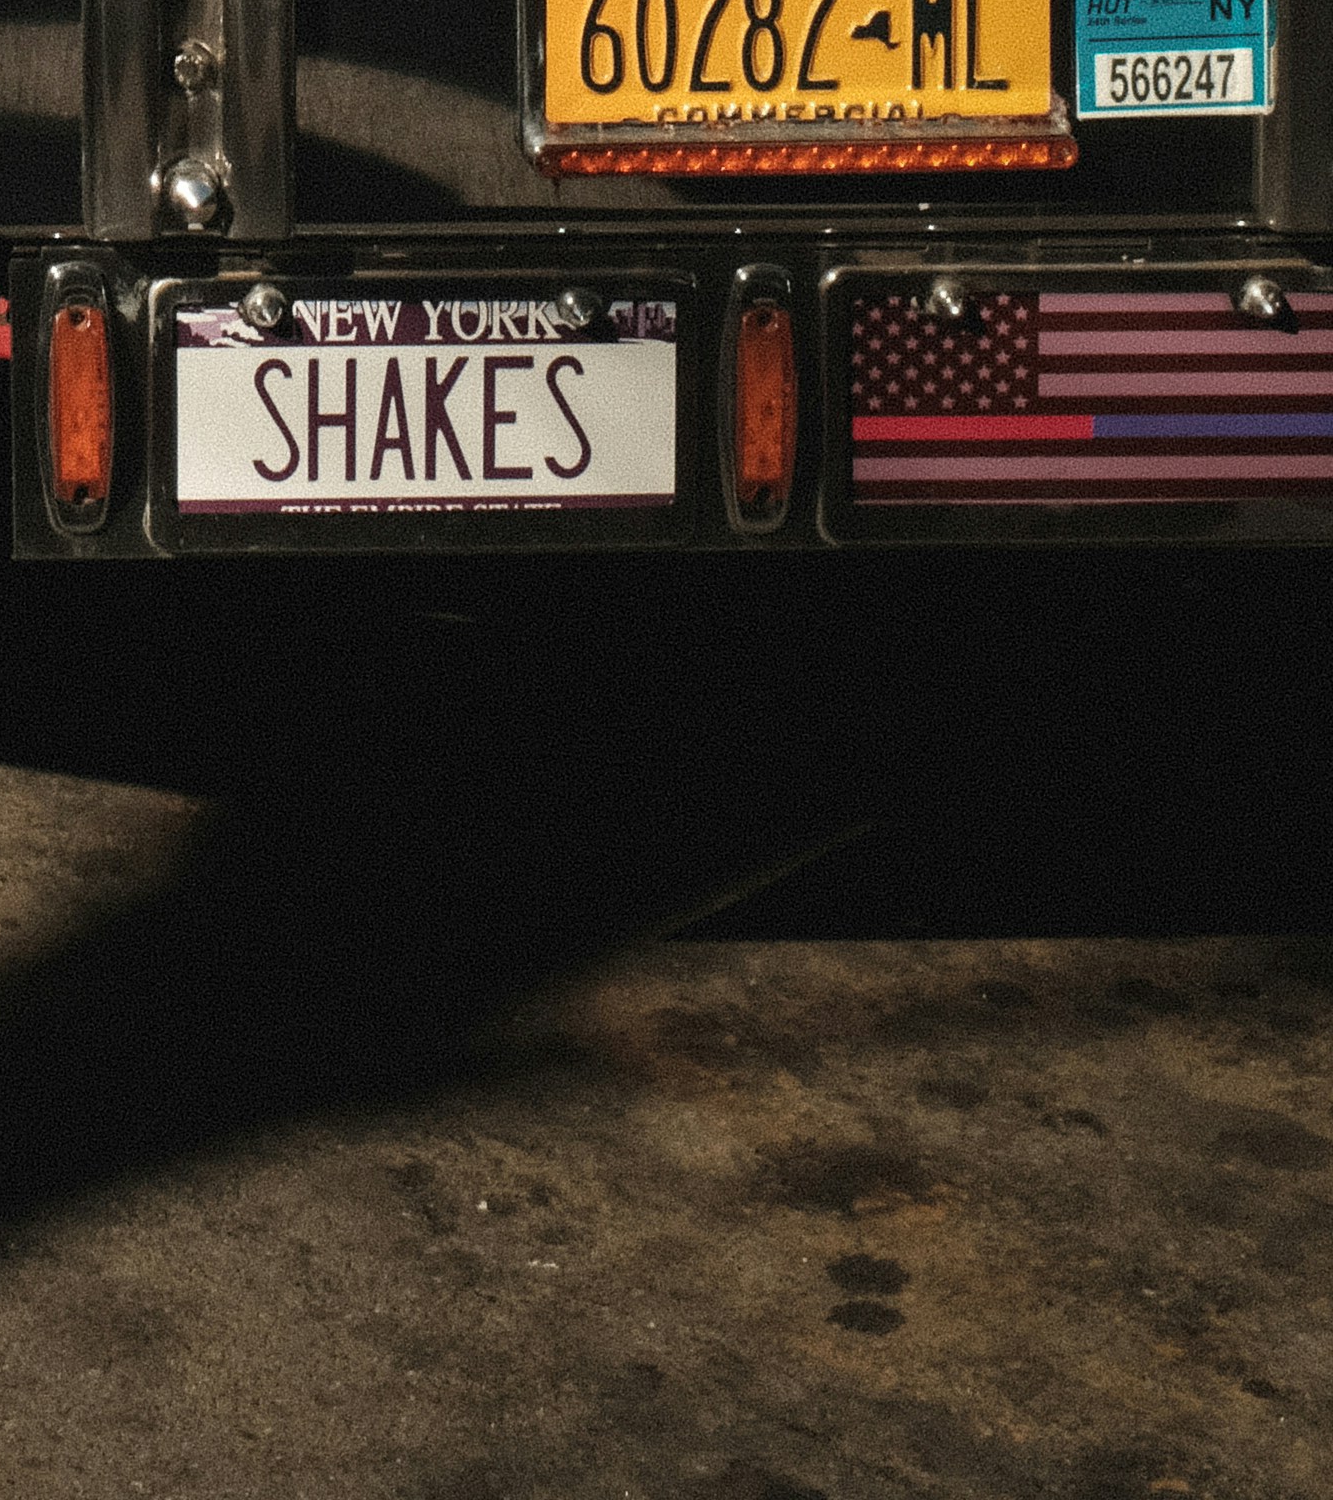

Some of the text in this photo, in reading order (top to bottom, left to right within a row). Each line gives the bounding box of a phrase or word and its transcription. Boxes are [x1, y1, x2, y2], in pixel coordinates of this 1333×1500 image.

[1109, 53, 1236, 104] 566247
[292, 300, 563, 342] NEW YORK
[252, 354, 593, 483] SHAKES
